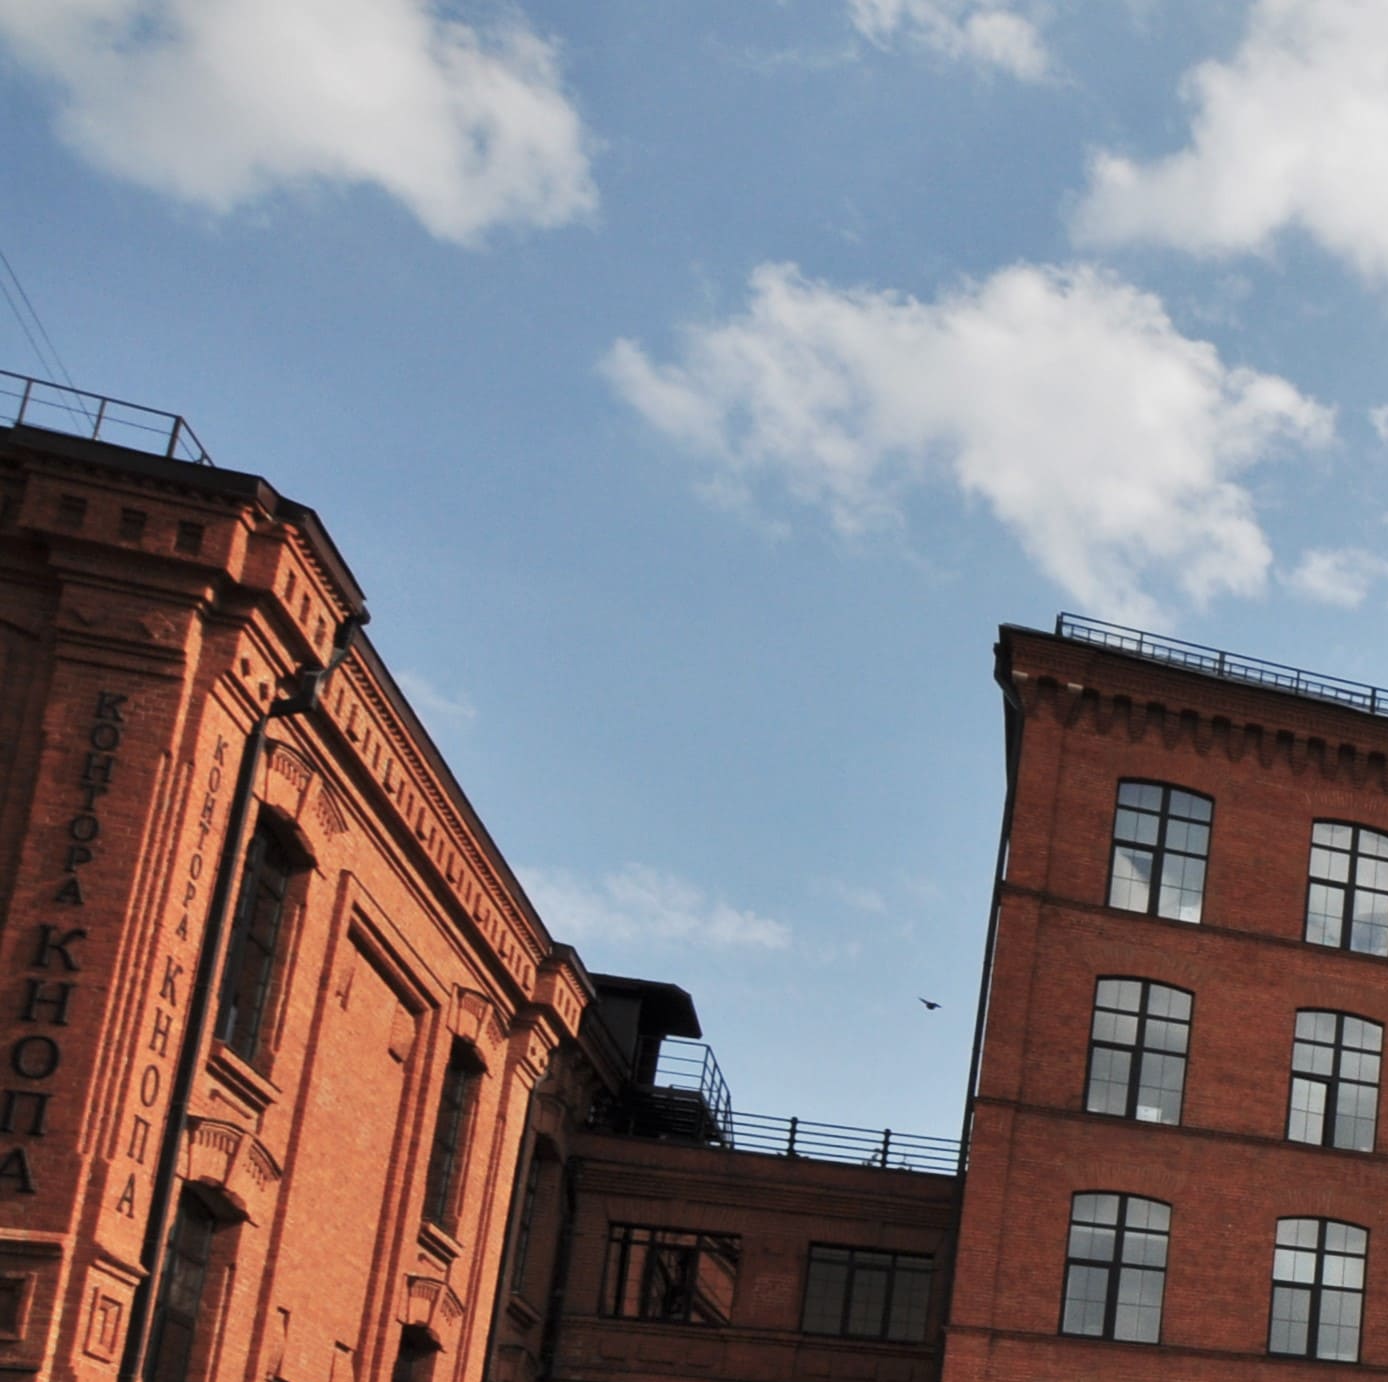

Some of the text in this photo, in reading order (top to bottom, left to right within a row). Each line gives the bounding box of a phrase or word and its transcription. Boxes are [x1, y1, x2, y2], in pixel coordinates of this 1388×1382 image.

[0, 690, 128, 1195] КОНТОРА КНОПА
[115, 733, 229, 1220] КОНТОРА КНОПА
